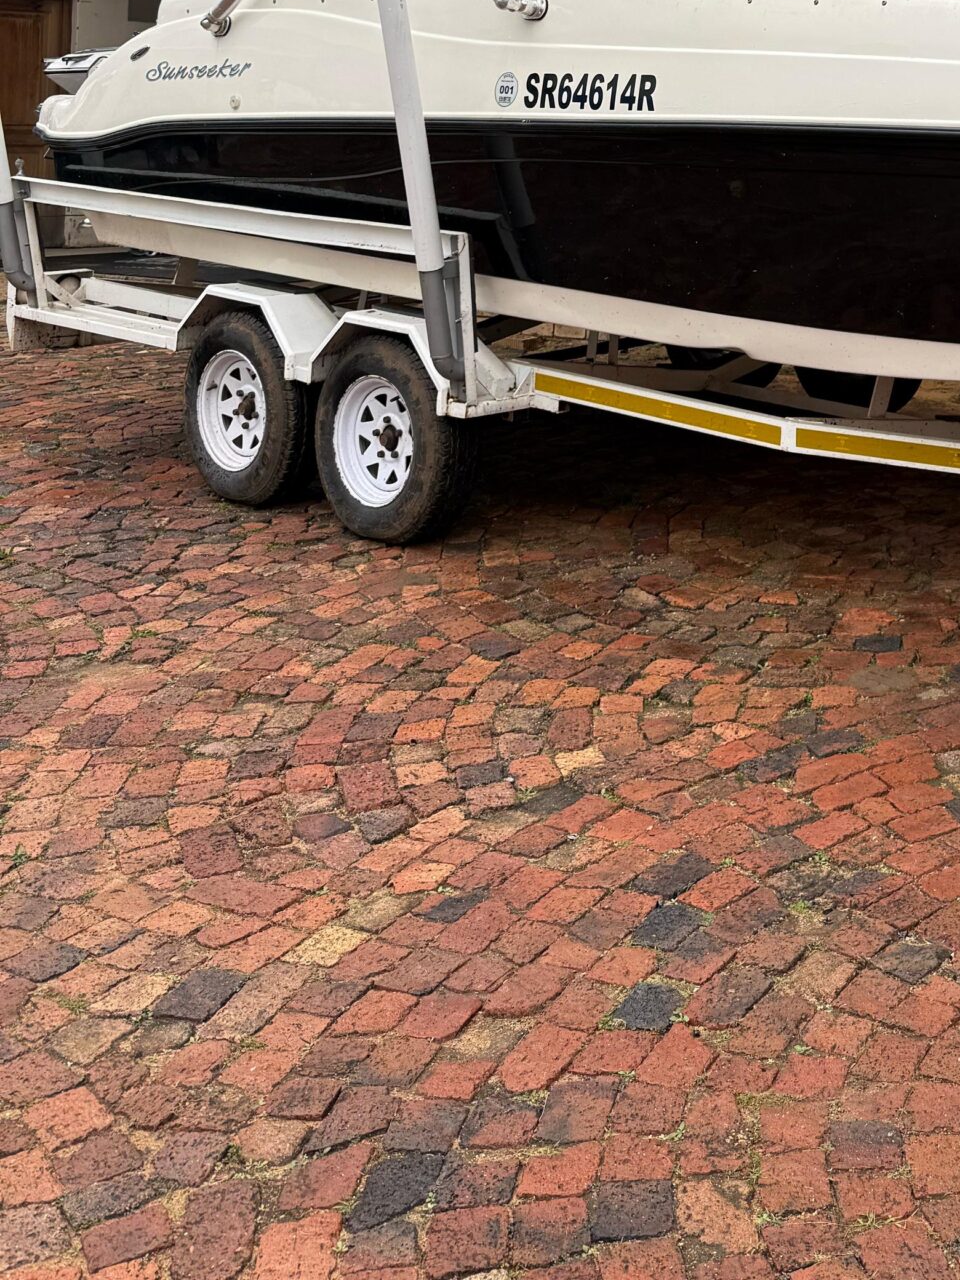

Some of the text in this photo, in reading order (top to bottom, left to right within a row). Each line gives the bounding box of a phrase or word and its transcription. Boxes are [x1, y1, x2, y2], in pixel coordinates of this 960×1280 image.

[145, 58, 252, 82] Sunseeker
[499, 85, 514, 95] 001
[523, 72, 657, 112] SR64614R
